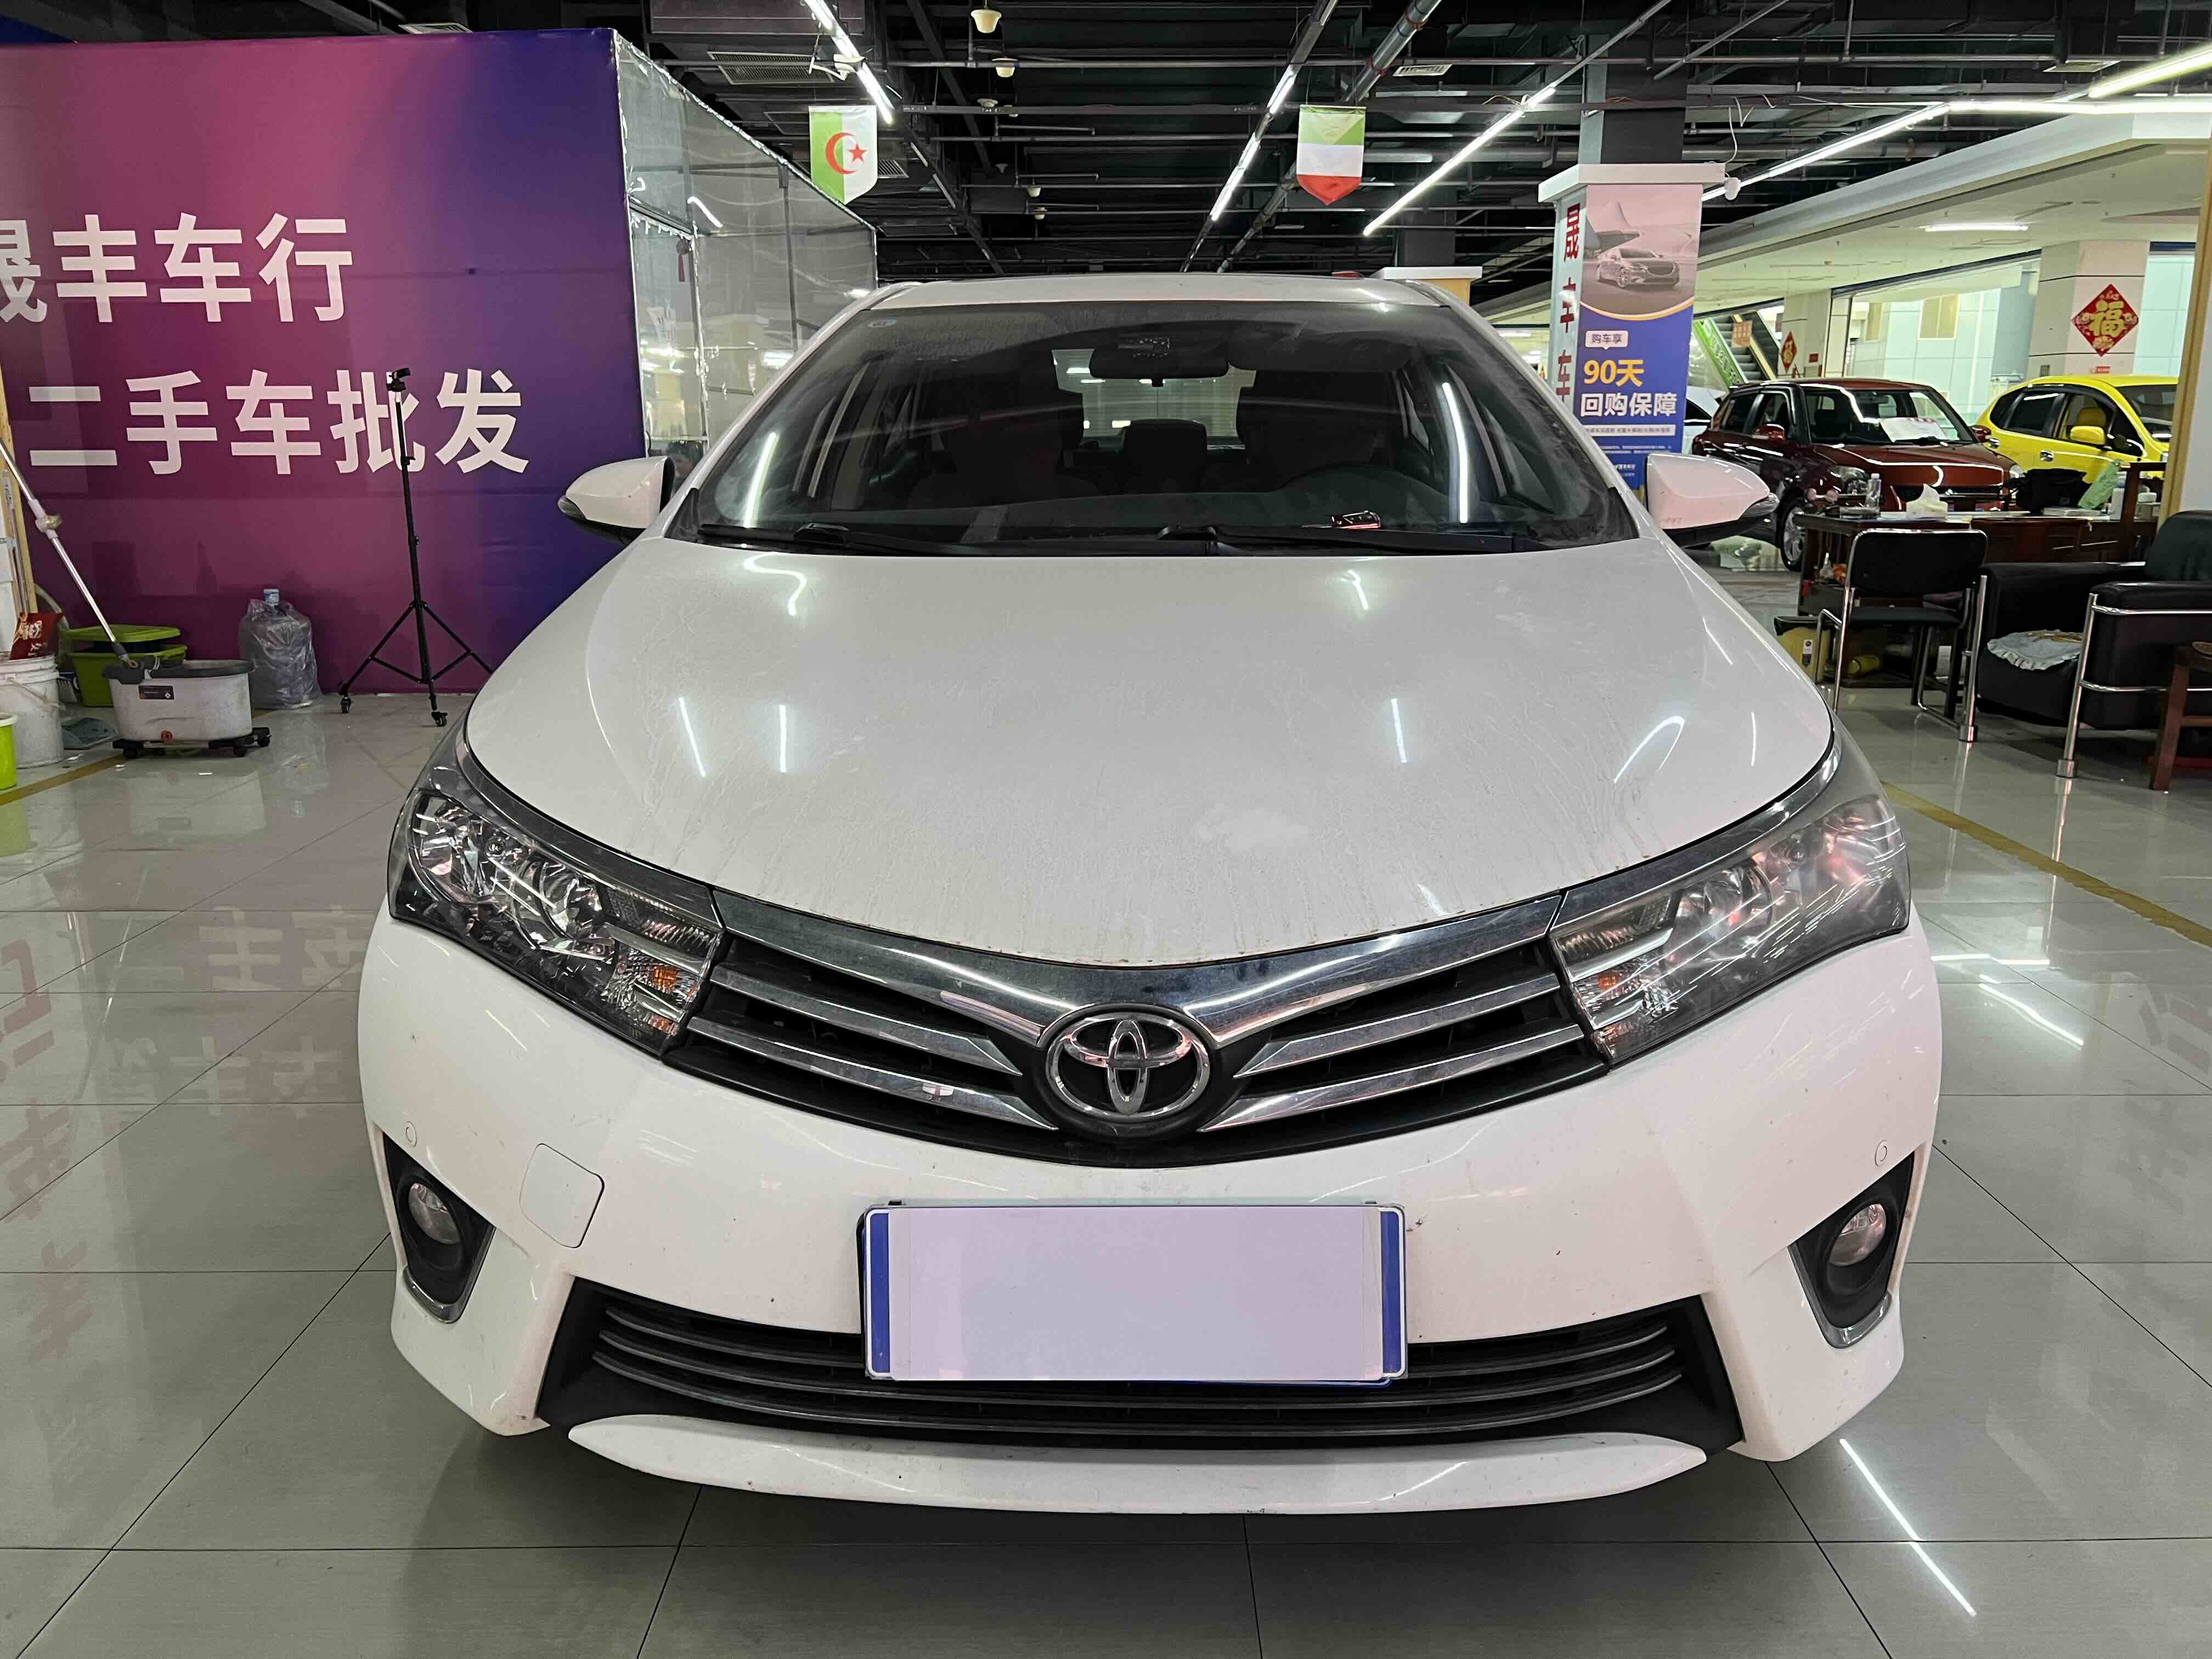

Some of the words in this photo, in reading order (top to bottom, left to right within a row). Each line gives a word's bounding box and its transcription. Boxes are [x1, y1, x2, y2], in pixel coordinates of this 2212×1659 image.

[2088, 300, 2125, 338] 福
[1592, 334, 1622, 344] 购车享
[1584, 359, 1645, 387] 90天
[1580, 392, 1677, 417] 回购保障
[29, 369, 529, 475] 二手车批发
